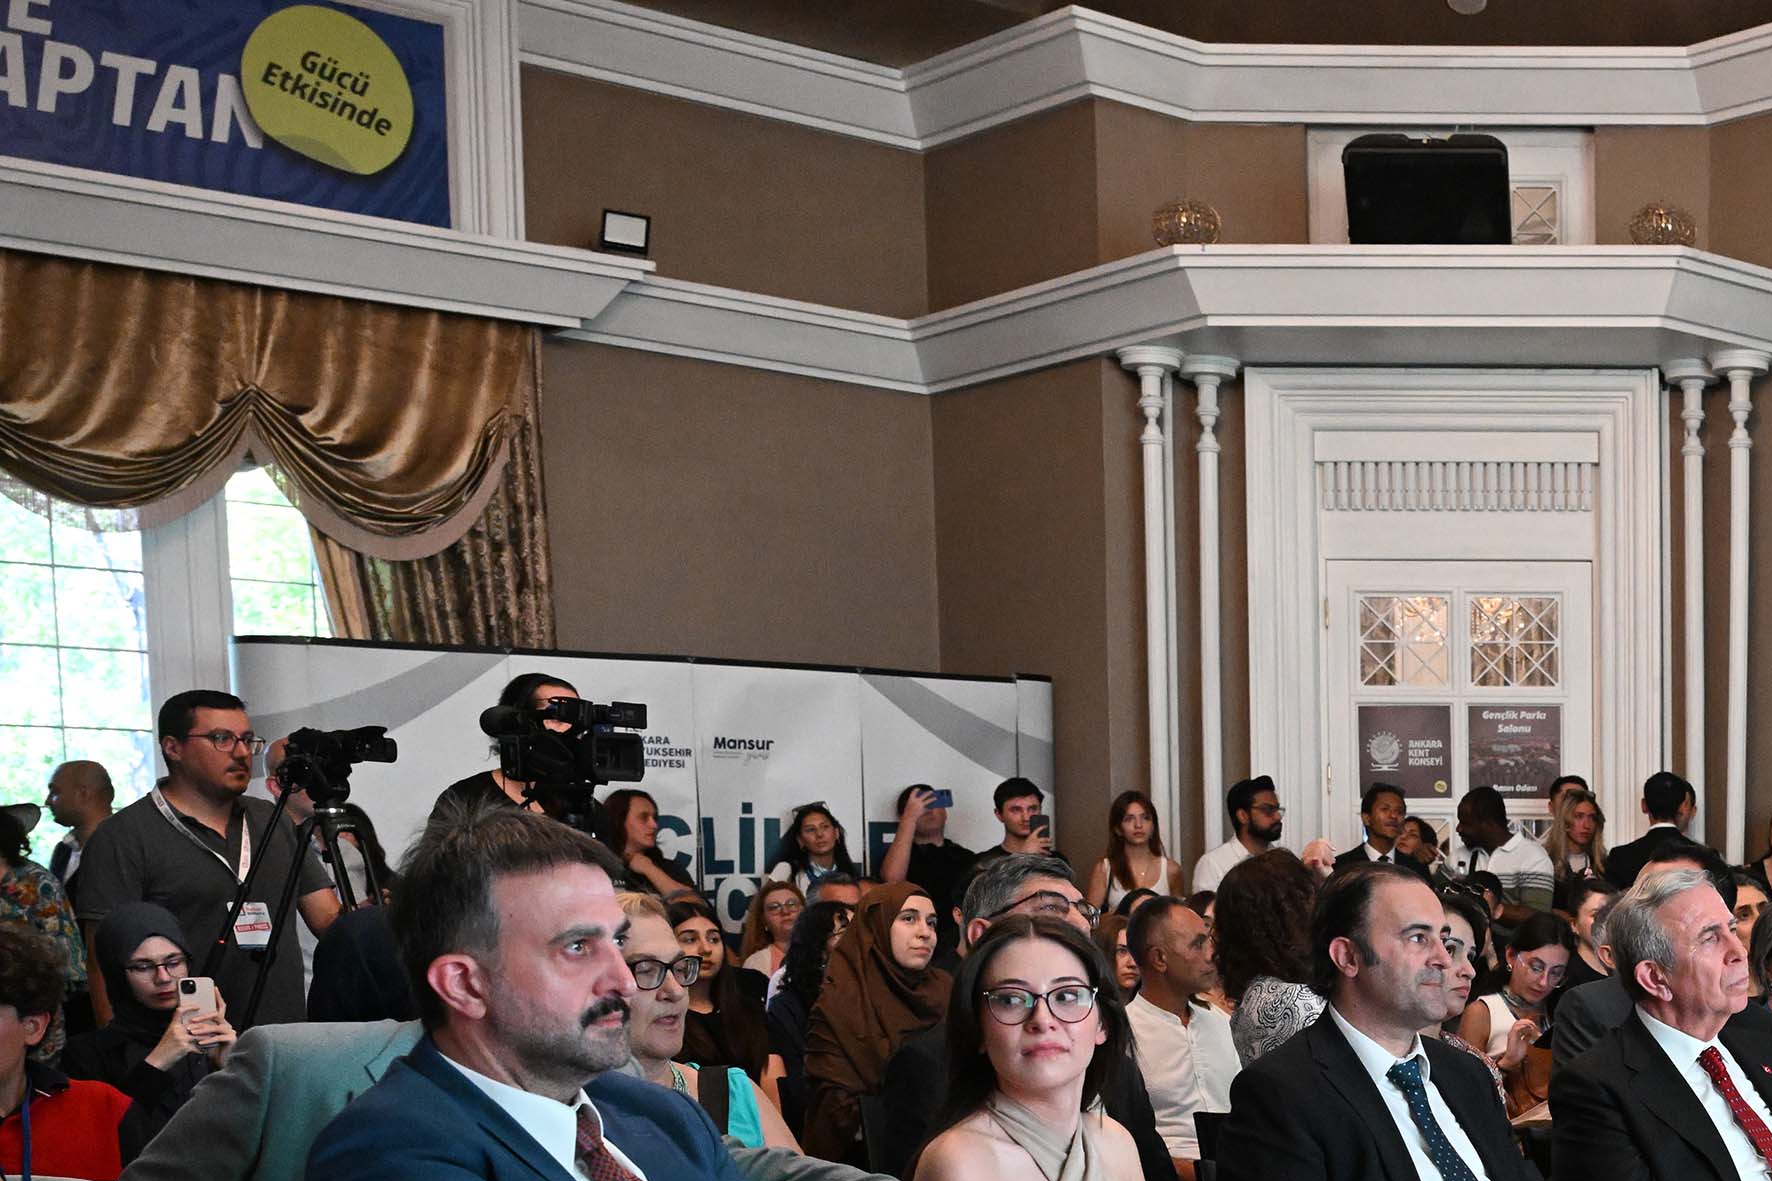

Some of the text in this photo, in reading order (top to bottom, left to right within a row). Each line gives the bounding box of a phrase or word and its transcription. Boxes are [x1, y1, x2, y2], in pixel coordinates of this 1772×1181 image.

[300, 50, 370, 97] Gücü
[261, 62, 393, 137] Etkisinde
[1482, 711, 1518, 721] Gençlik
[1497, 724, 1532, 733] Salonu
[641, 735, 670, 745] KARA
[713, 736, 775, 750] Mansur
[1408, 739, 1443, 748] ANKARA
[1408, 749, 1430, 757] KENT
